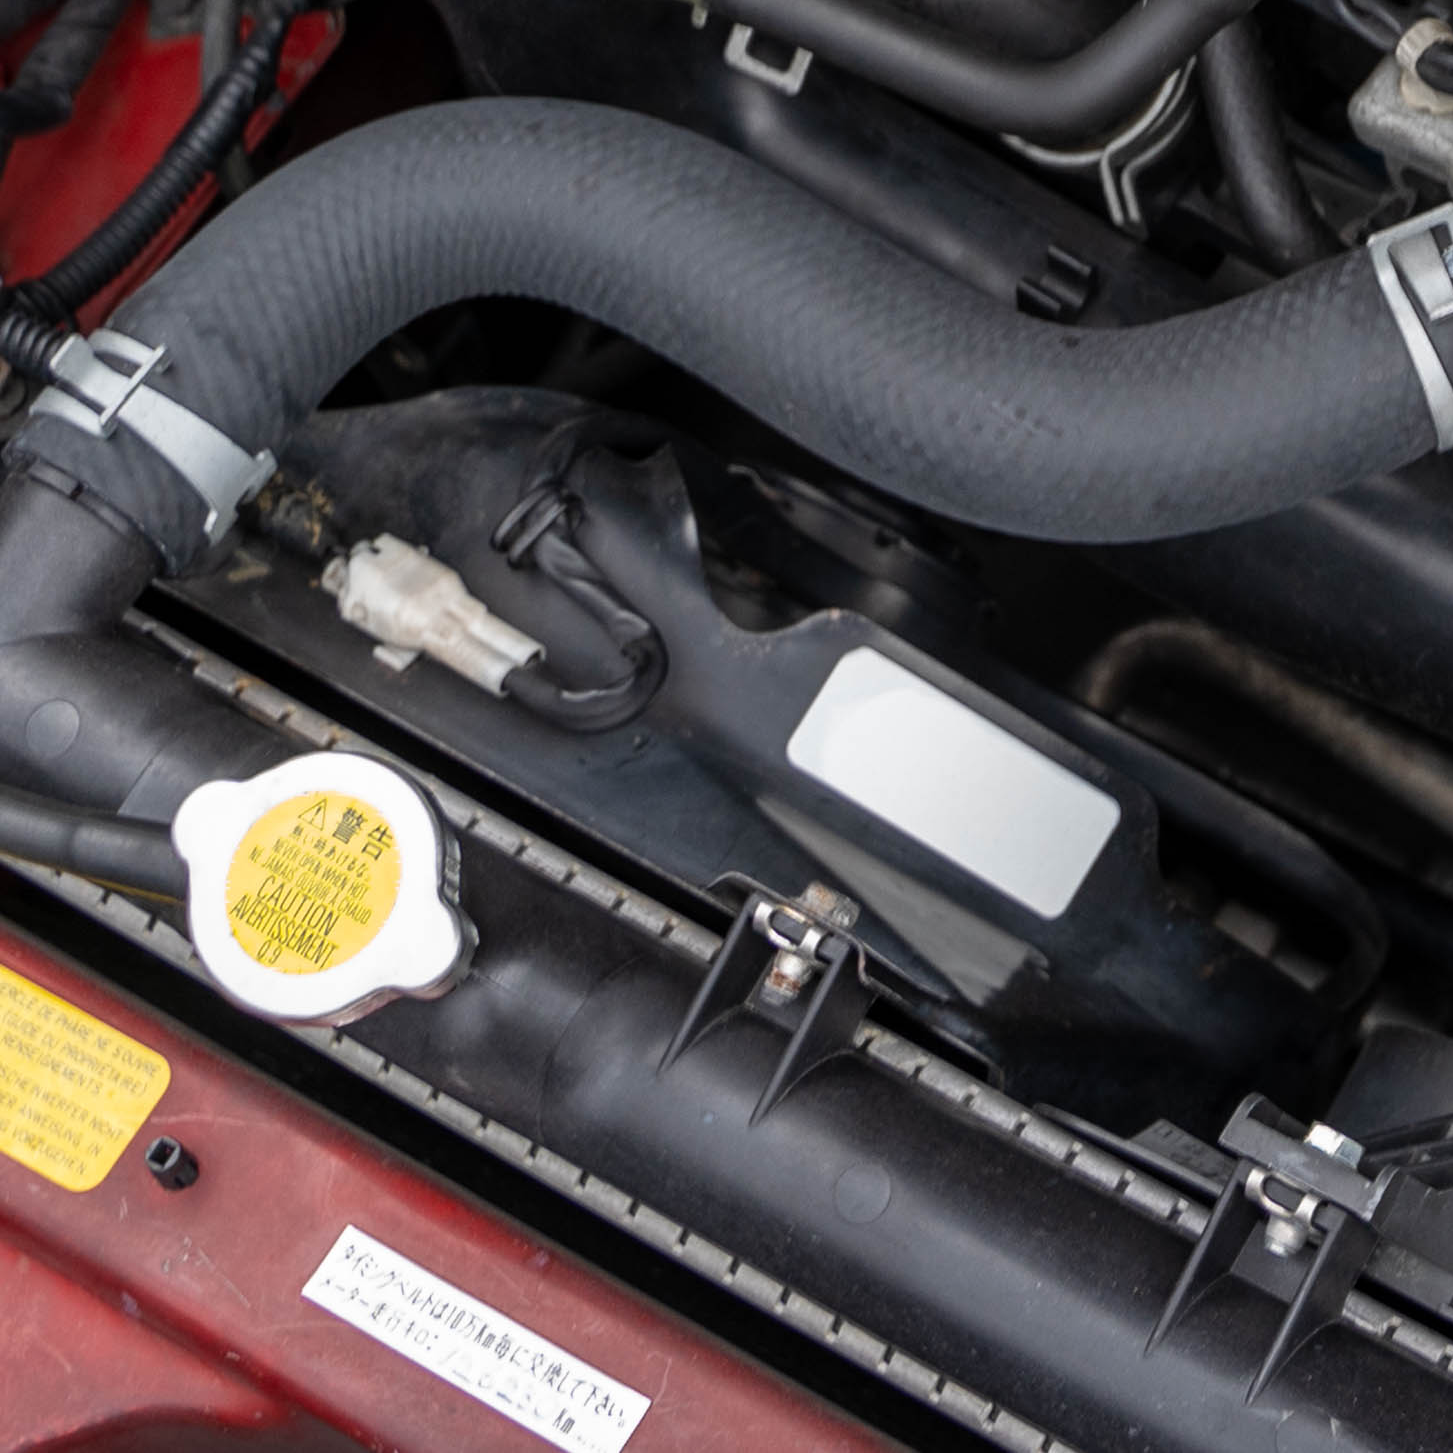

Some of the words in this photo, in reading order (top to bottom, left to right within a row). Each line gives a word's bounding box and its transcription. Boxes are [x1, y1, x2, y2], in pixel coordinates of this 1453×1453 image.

[332, 806, 393, 862] 警告
[261, 855, 297, 884] JAMAIS
[295, 873, 331, 902] OUVRIR
[340, 896, 373, 925] CHAUD
[271, 838, 299, 865] NEVER
[298, 851, 323, 876] OPEN
[321, 864, 349, 891] WHEN
[348, 876, 370, 901] HOT
[230, 894, 340, 970] AVERTISSEMENT
[256, 874, 341, 937] CAUTION
[255, 939, 283, 966] 0.9
